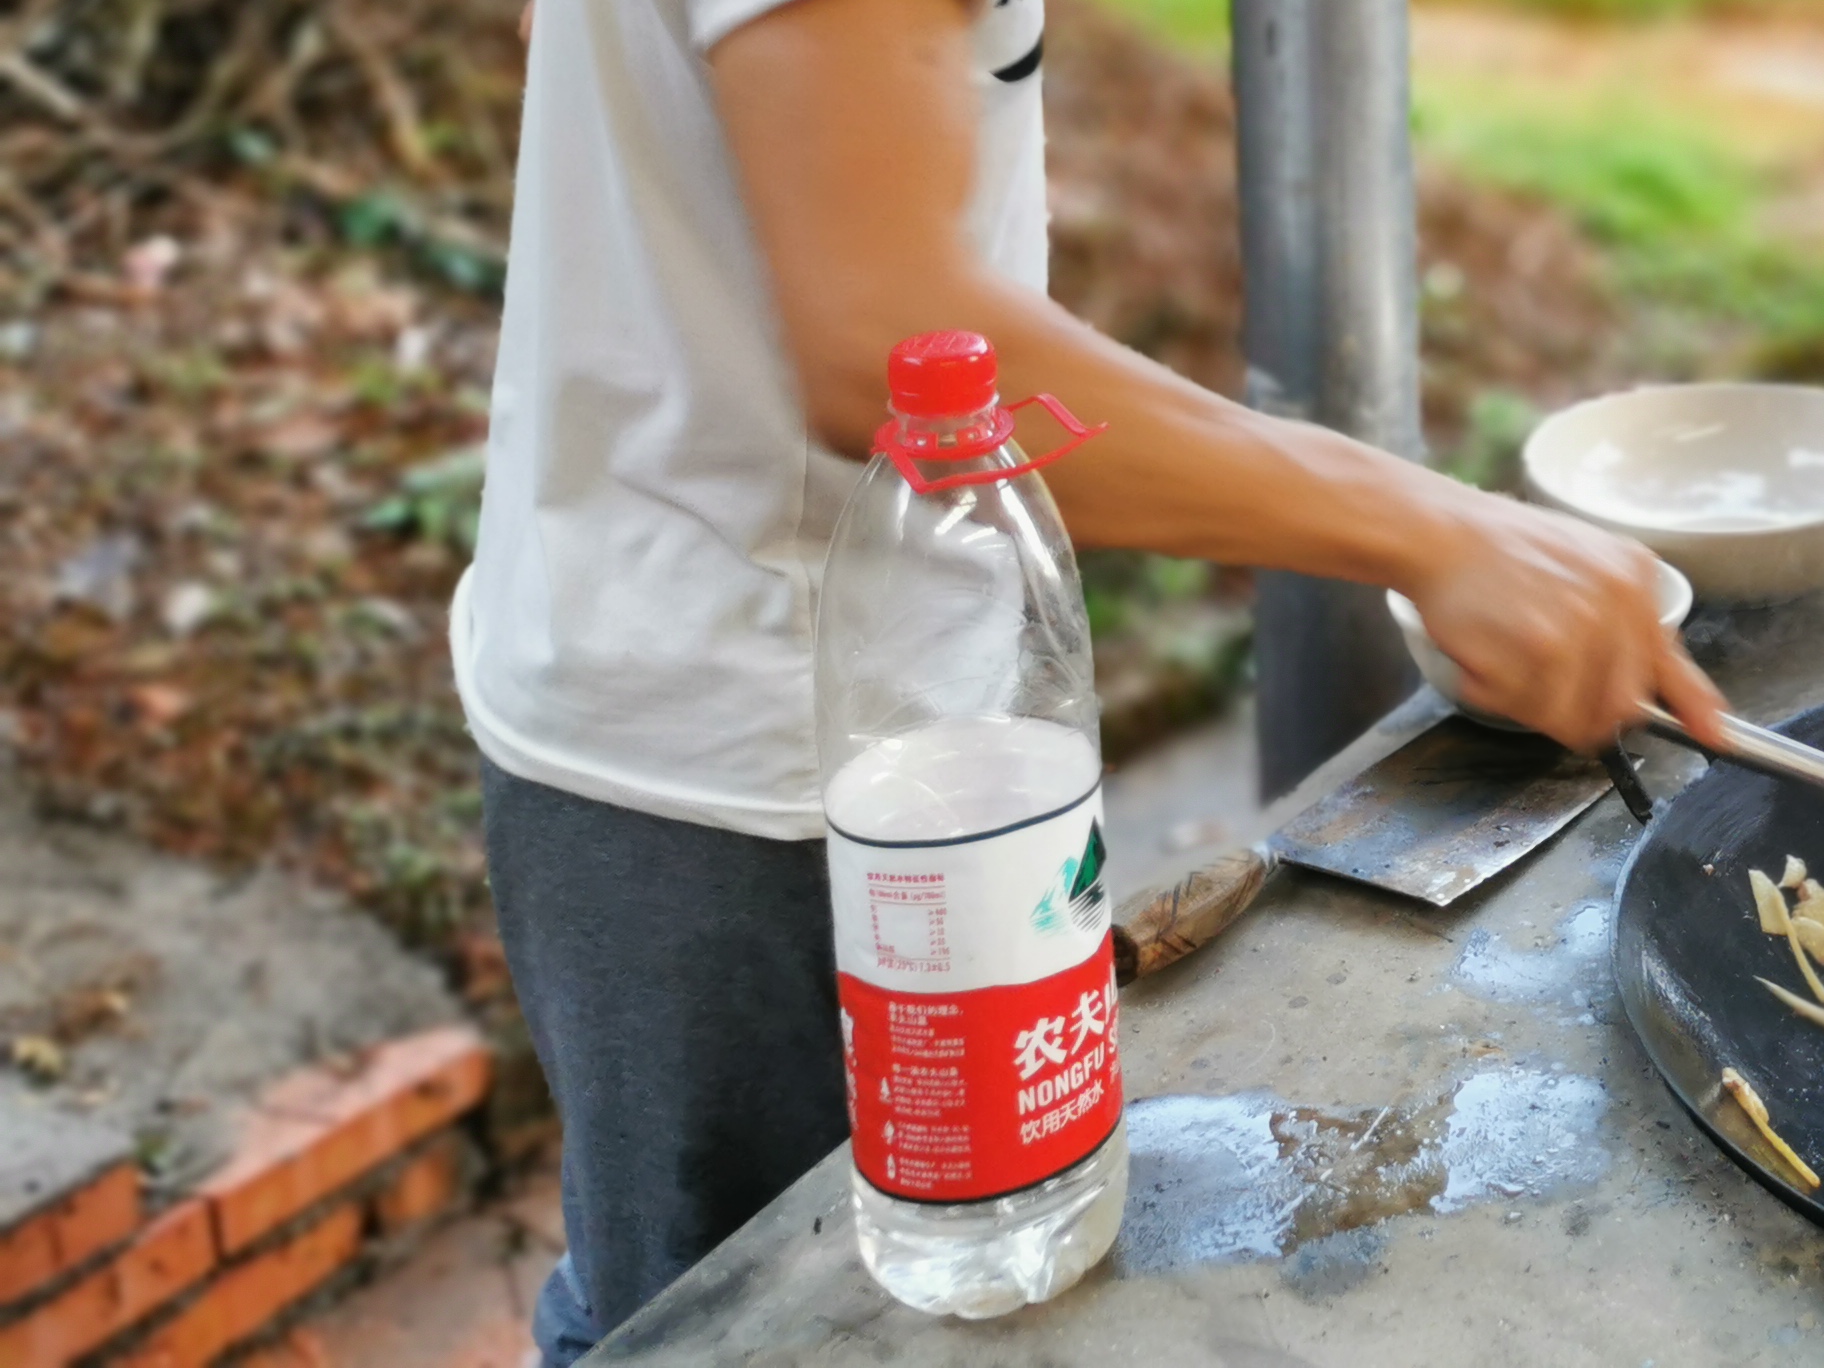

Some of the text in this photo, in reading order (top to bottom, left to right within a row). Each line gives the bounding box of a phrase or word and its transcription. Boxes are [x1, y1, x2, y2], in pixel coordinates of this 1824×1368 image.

[1018, 1041, 1105, 1115] NONGFU
[1019, 1079, 1105, 1145] 饮用天然水
